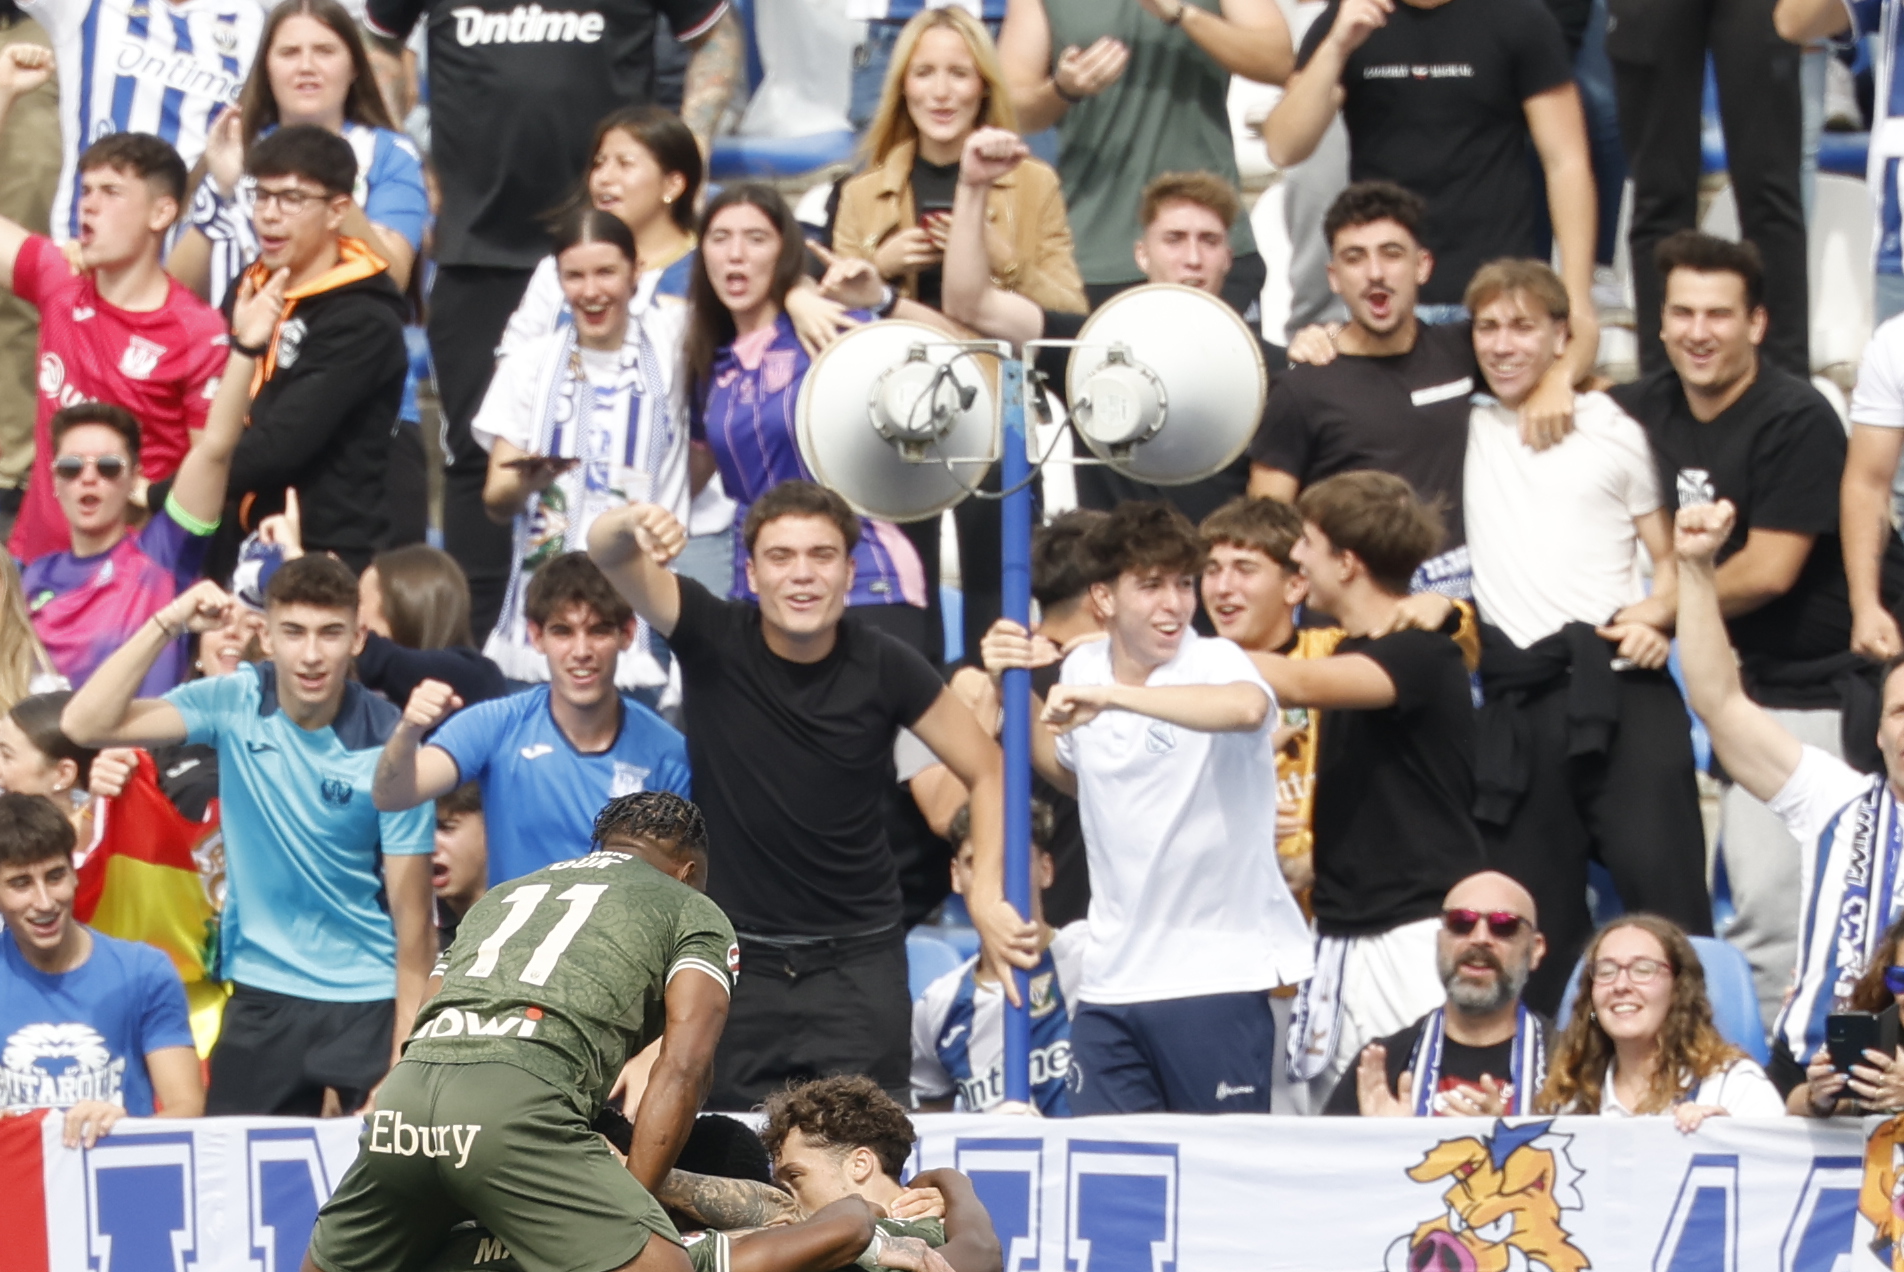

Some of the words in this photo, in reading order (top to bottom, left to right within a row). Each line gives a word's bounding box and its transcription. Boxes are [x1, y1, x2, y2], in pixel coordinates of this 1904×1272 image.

[450, 3, 605, 47] Ontime
[465, 884, 609, 987] 11
[368, 1109, 482, 1168] Ebury
